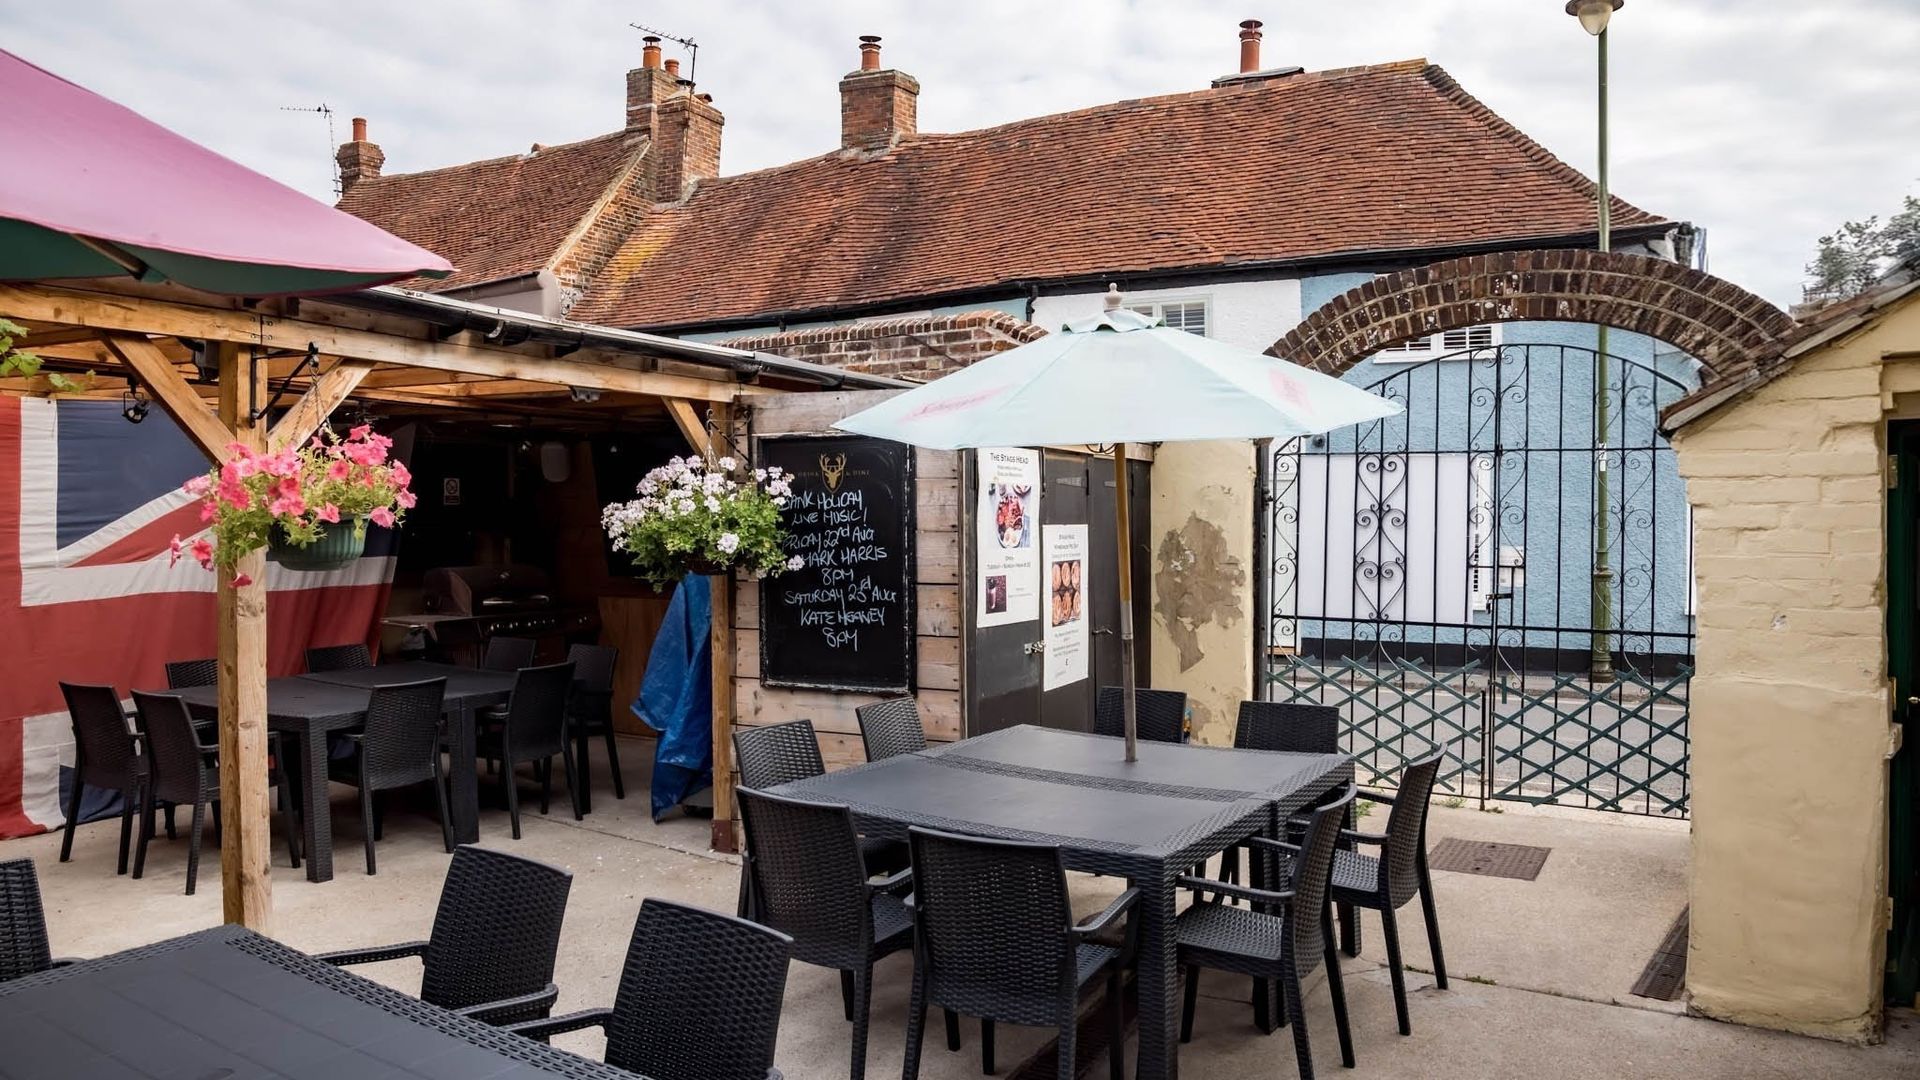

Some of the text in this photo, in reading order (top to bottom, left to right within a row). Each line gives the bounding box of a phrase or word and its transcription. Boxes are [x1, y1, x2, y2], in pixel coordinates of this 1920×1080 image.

[817, 489, 863, 511] HOLIDAY
[791, 512, 819, 526] LIVE
[852, 526, 875, 543] AUG
[840, 545, 888, 565] HARRIS
[784, 587, 846, 608] SATURDAY
[799, 608, 837, 627] KATE
